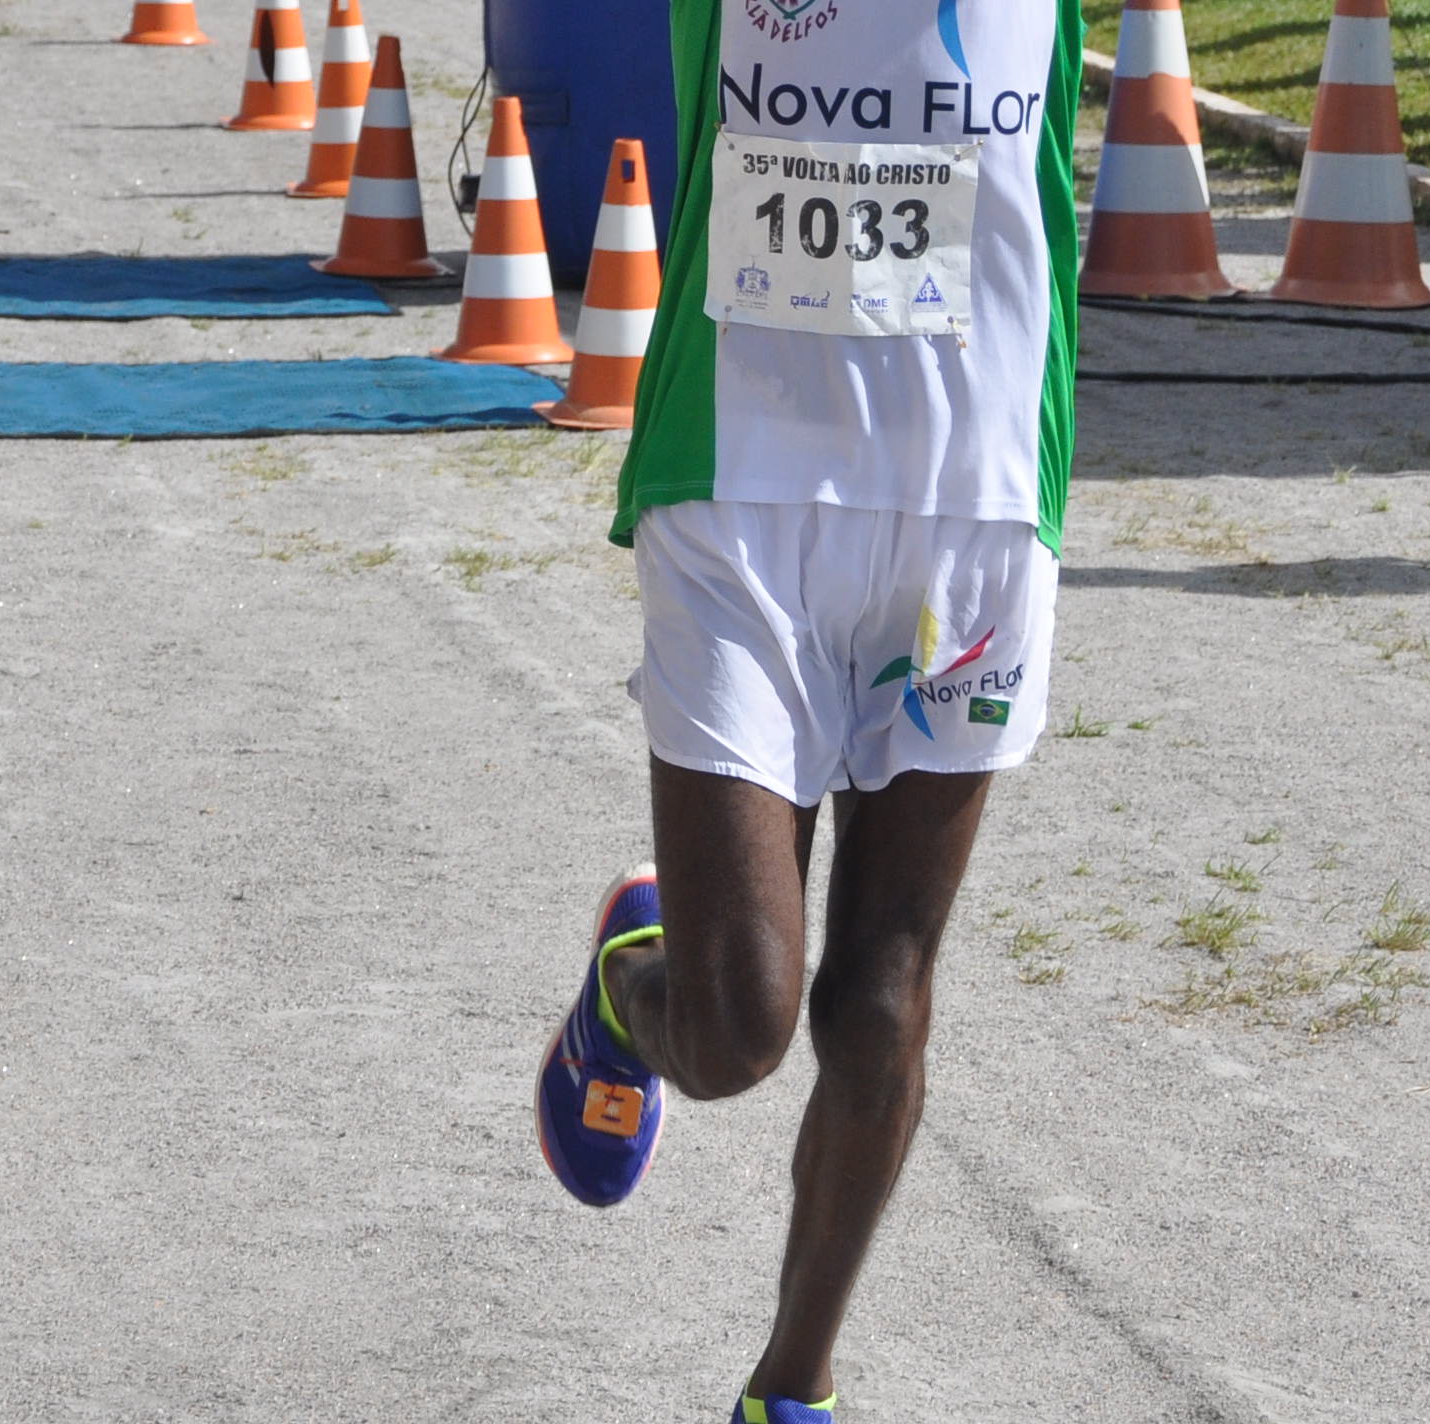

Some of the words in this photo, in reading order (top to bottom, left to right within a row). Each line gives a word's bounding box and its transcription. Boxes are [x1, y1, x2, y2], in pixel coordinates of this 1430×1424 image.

[770, 0, 839, 43] DELFOS
[719, 63, 892, 130] Nova
[782, 156, 841, 184] VOLTA
[843, 163, 871, 185] AO
[876, 164, 951, 186] CRISTO
[755, 192, 931, 262] 1033
[917, 680, 973, 705] Nova
